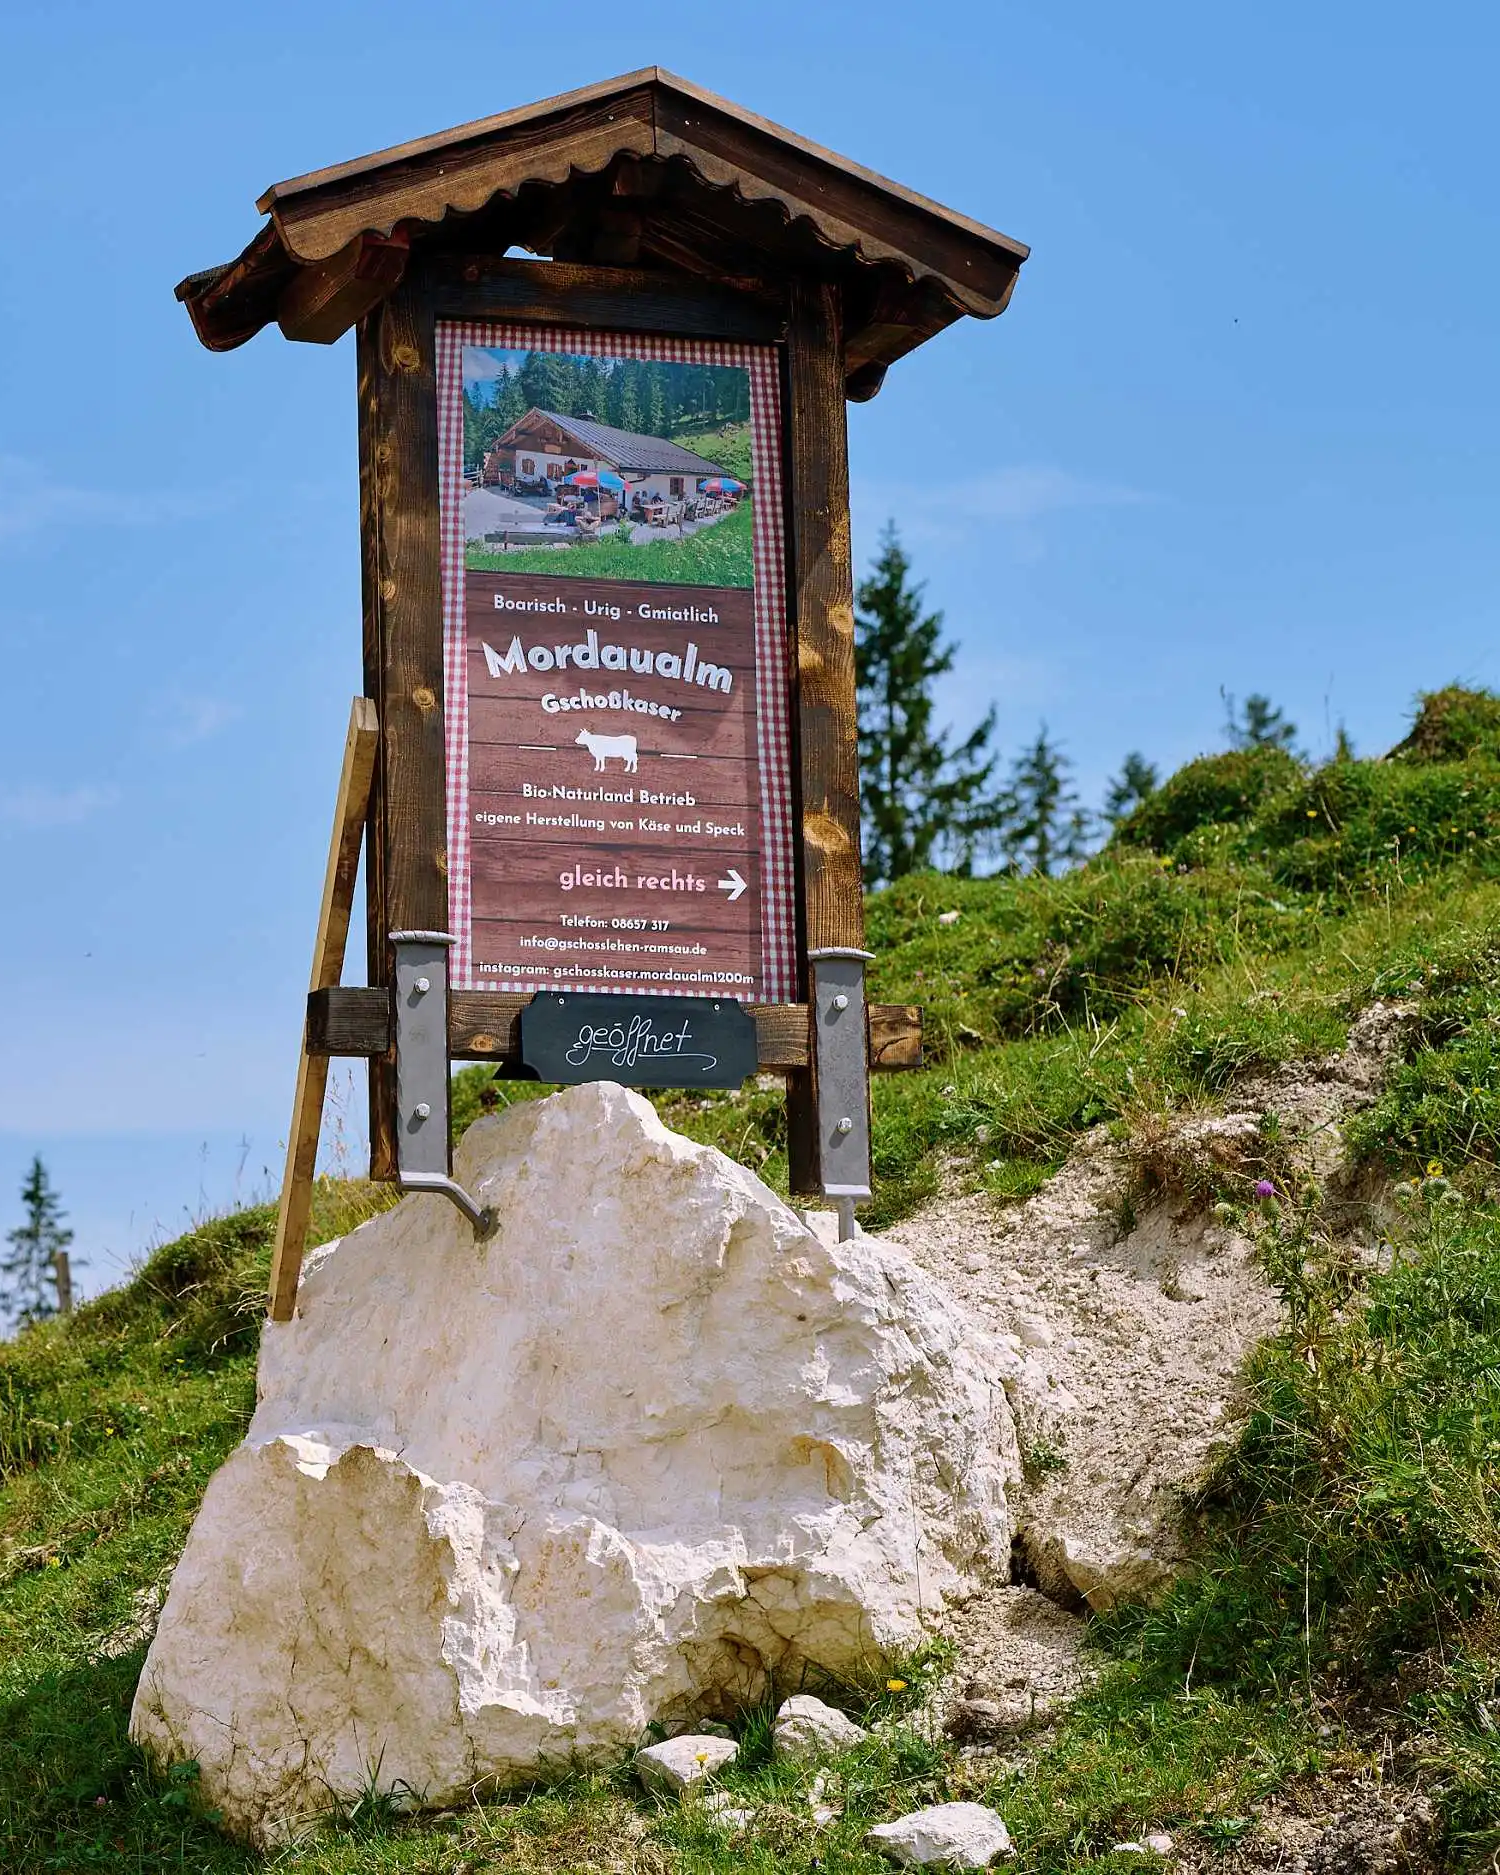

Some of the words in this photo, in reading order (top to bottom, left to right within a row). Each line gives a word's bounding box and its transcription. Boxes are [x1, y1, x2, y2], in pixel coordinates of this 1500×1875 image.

[494, 594, 566, 613] Boarisch
[584, 600, 621, 620] Urig
[638, 604, 719, 624] Gmiatlich
[482, 629, 733, 694] Mordaualm
[541, 688, 682, 722] Gschoßkaser
[522, 784, 634, 803] Bio-Naturland
[640, 789, 696, 806] Betrieb
[475, 811, 522, 826] eigene
[526, 812, 605, 832] Herstellung
[610, 820, 634, 831] von
[639, 818, 672, 832] Käse
[676, 821, 701, 834] und
[706, 822, 745, 838] Speck
[559, 864, 628, 891] gleich
[637, 869, 707, 892] rechts
[560, 915, 609, 929] Telefon:
[611, 918, 647, 930] 08657
[651, 920, 669, 931] 317
[520, 937, 708, 956] info@gschosslehen-ramsau.de
[480, 962, 550, 976] instagram:
[553, 964, 754, 984] gschosskaser.mordaualm1200m
[566, 1015, 694, 1067] geöffnet
